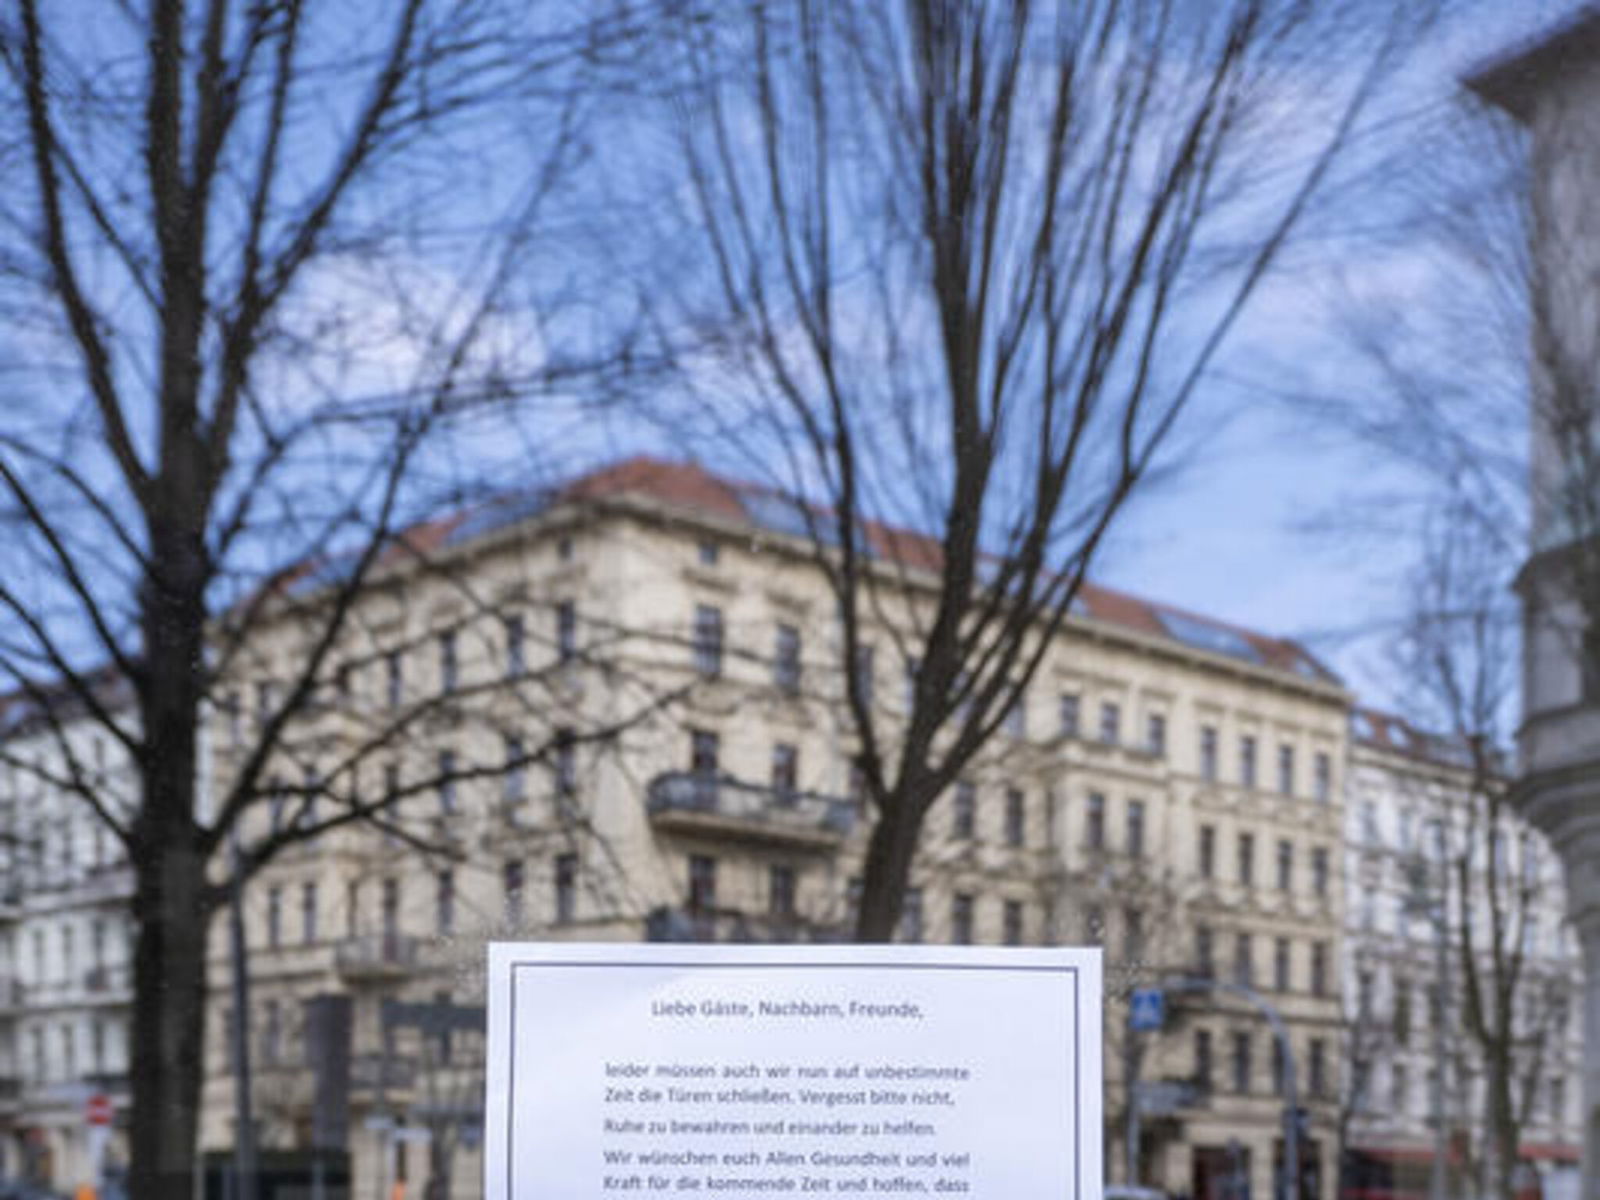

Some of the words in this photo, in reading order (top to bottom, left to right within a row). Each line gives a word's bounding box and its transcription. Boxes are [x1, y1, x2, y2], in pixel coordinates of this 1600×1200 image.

[651, 1000, 697, 1018] Liebe
[699, 999, 754, 1018] Gäste,
[758, 1000, 845, 1018] Nachbarn,
[849, 1000, 924, 1021] Freunde,
[605, 1062, 650, 1078] leider
[654, 1063, 717, 1079] müssen
[721, 1062, 761, 1079] auch
[764, 1064, 792, 1078] wir
[797, 1067, 829, 1079] nun
[833, 1064, 860, 1080] auf
[864, 1064, 971, 1081] unbestimmte
[604, 1086, 634, 1103] Zeit
[639, 1086, 663, 1103] die
[667, 1086, 712, 1103] Türen
[716, 1087, 796, 1104] schließen.
[798, 1088, 866, 1109] Vergesst
[870, 1089, 908, 1105] bitte
[911, 1089, 955, 1107] nicht,
[603, 1118, 645, 1134] Ruhe
[648, 1121, 667, 1134] zu
[670, 1119, 751, 1135] bewahren
[753, 1120, 785, 1135] und
[787, 1119, 858, 1136] einander
[861, 1123, 880, 1136] zu
[882, 1119, 936, 1136] helfen.
[603, 1150, 633, 1165] Wir
[637, 1150, 718, 1166] wünschen
[722, 1150, 761, 1166] euch
[765, 1150, 807, 1167] Allen
[810, 1150, 901, 1168] Gesundheit
[905, 1152, 938, 1168] und
[940, 1152, 970, 1168] viel
[603, 1174, 642, 1191] Kraft
[648, 1174, 671, 1191] für
[676, 1175, 701, 1191] die
[706, 1175, 796, 1192] kommende
[800, 1176, 831, 1192] Zeit
[837, 1175, 868, 1193] und
[872, 1175, 929, 1195] hoffen,
[934, 1176, 970, 1193] dass
